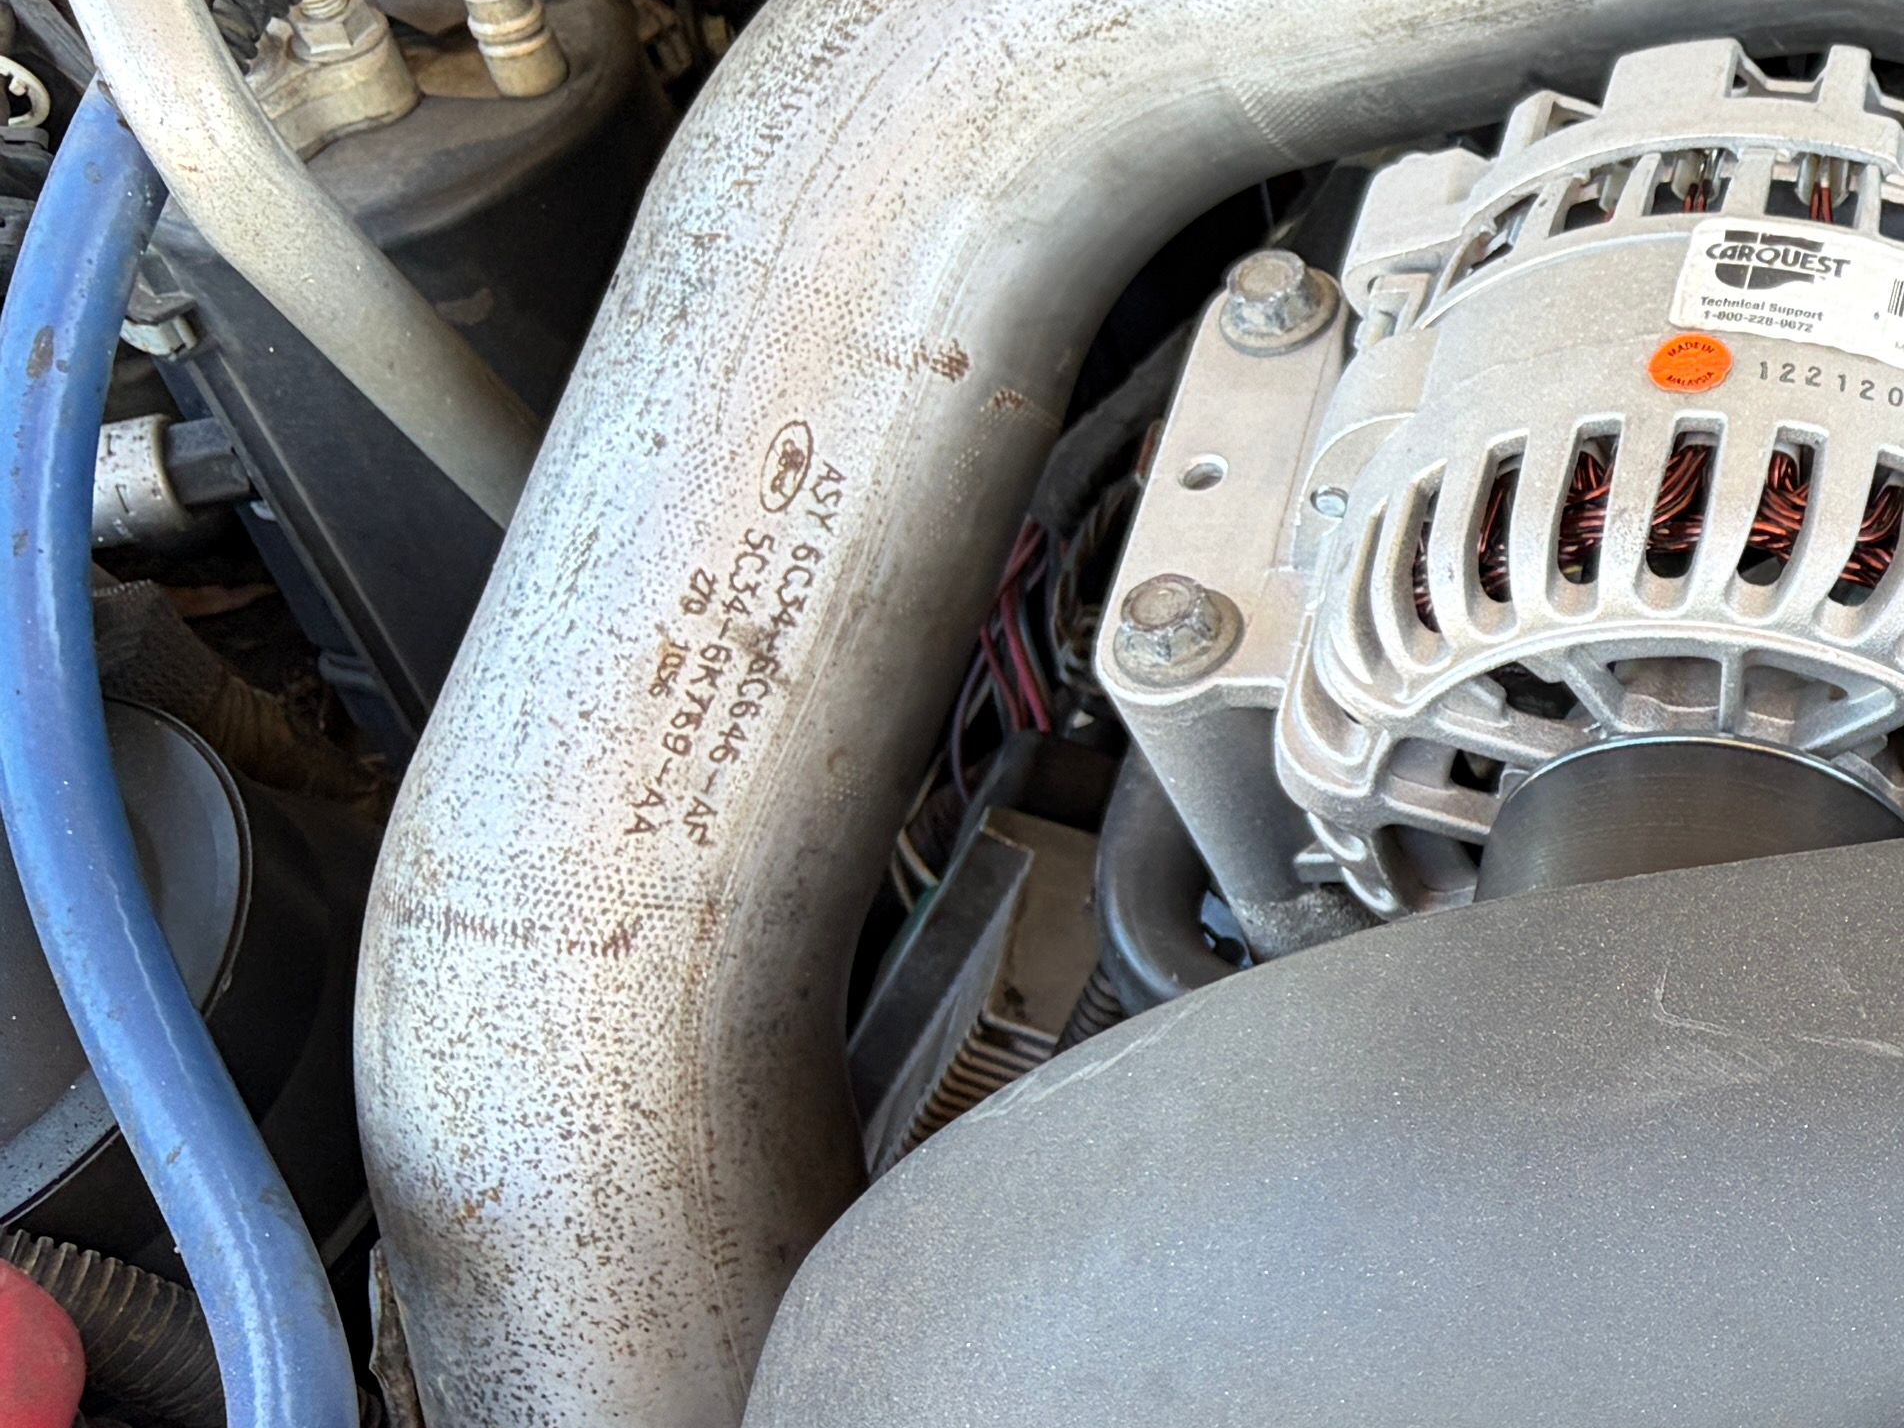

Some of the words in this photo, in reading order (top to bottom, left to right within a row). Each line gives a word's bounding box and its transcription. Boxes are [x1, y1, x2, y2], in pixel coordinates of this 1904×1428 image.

[1705, 242, 1851, 279] CARQUEST
[1699, 294, 1766, 313] Technical
[1768, 301, 1825, 323] Support
[1667, 341, 1699, 357] MADE
[1701, 344, 1716, 354] IN
[1665, 371, 1715, 387] MALAYSIA
[806, 461, 847, 534] ASY
